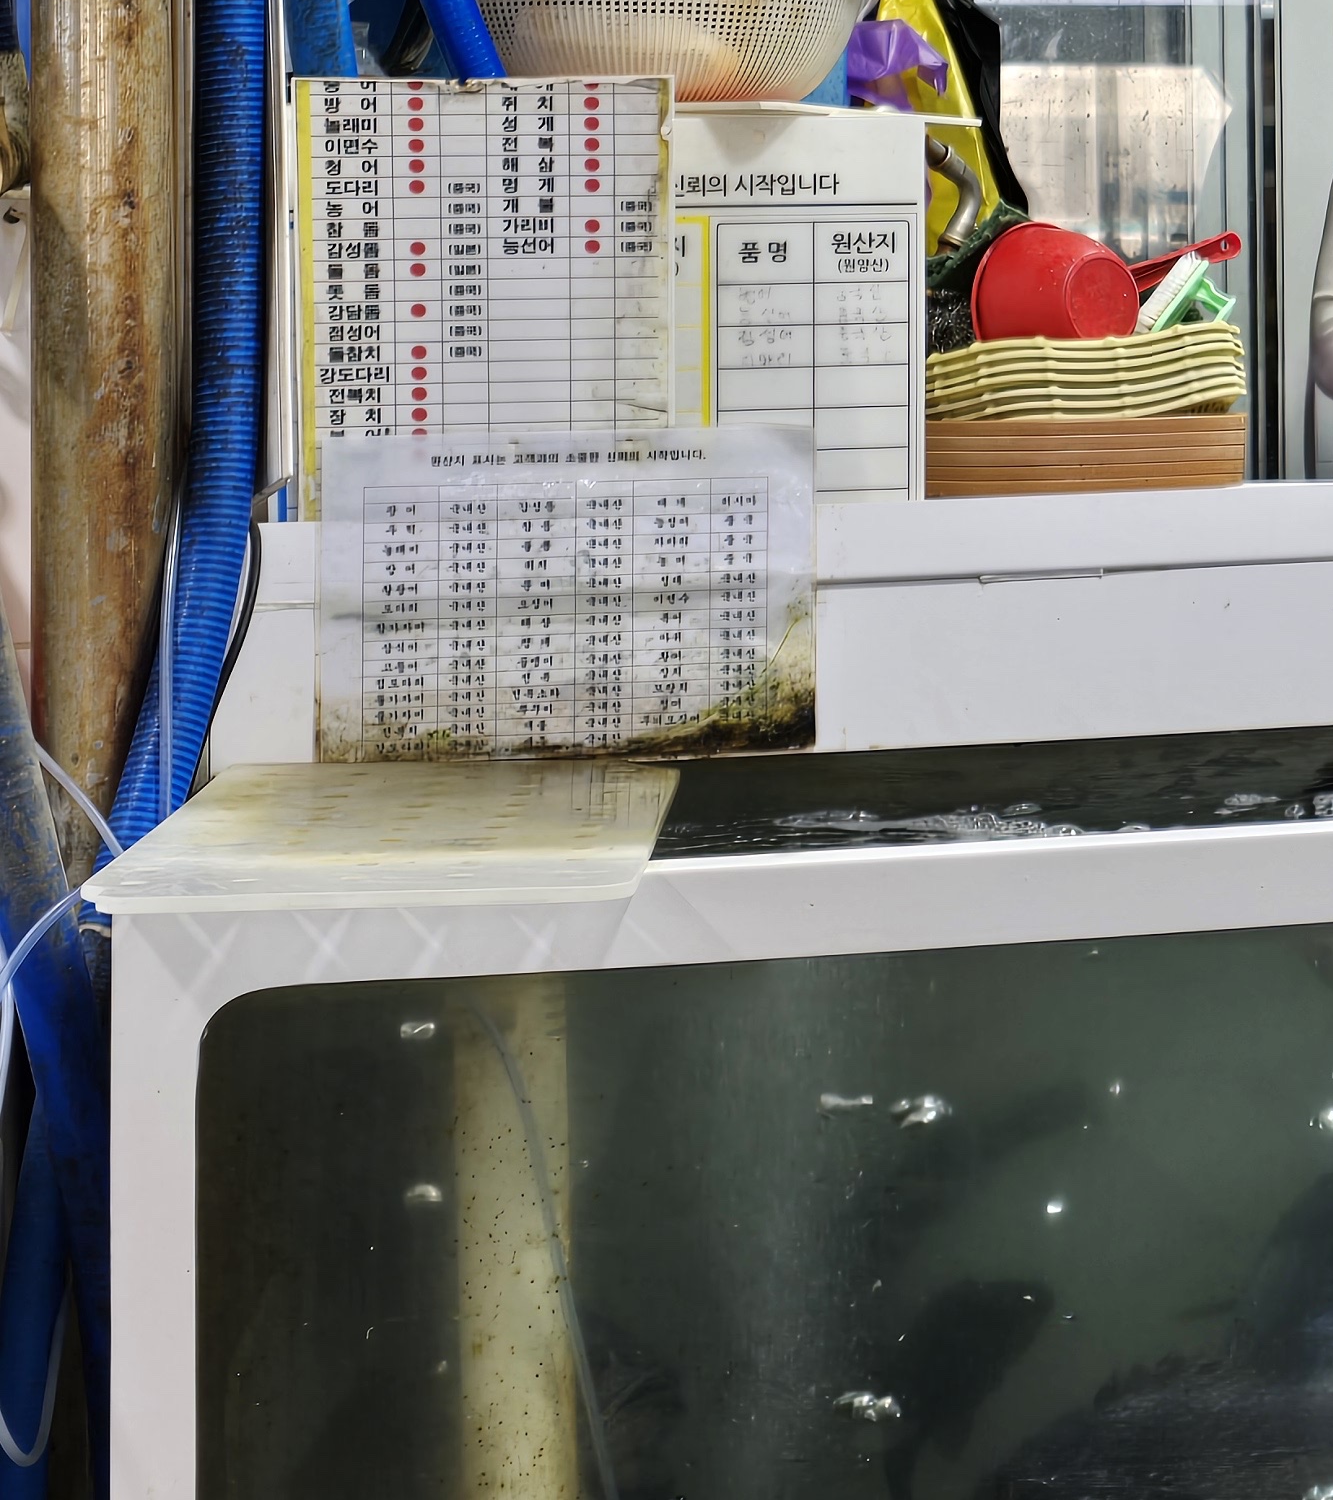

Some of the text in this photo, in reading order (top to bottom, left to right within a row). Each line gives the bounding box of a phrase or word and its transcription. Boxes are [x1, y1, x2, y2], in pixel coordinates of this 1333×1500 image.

[325, 179, 378, 196] 도다리
[734, 173, 840, 196] 시작입니다
[502, 217, 554, 234] 가리비
[831, 231, 896, 255] 원산지
[320, 366, 390, 384] 강도다리
